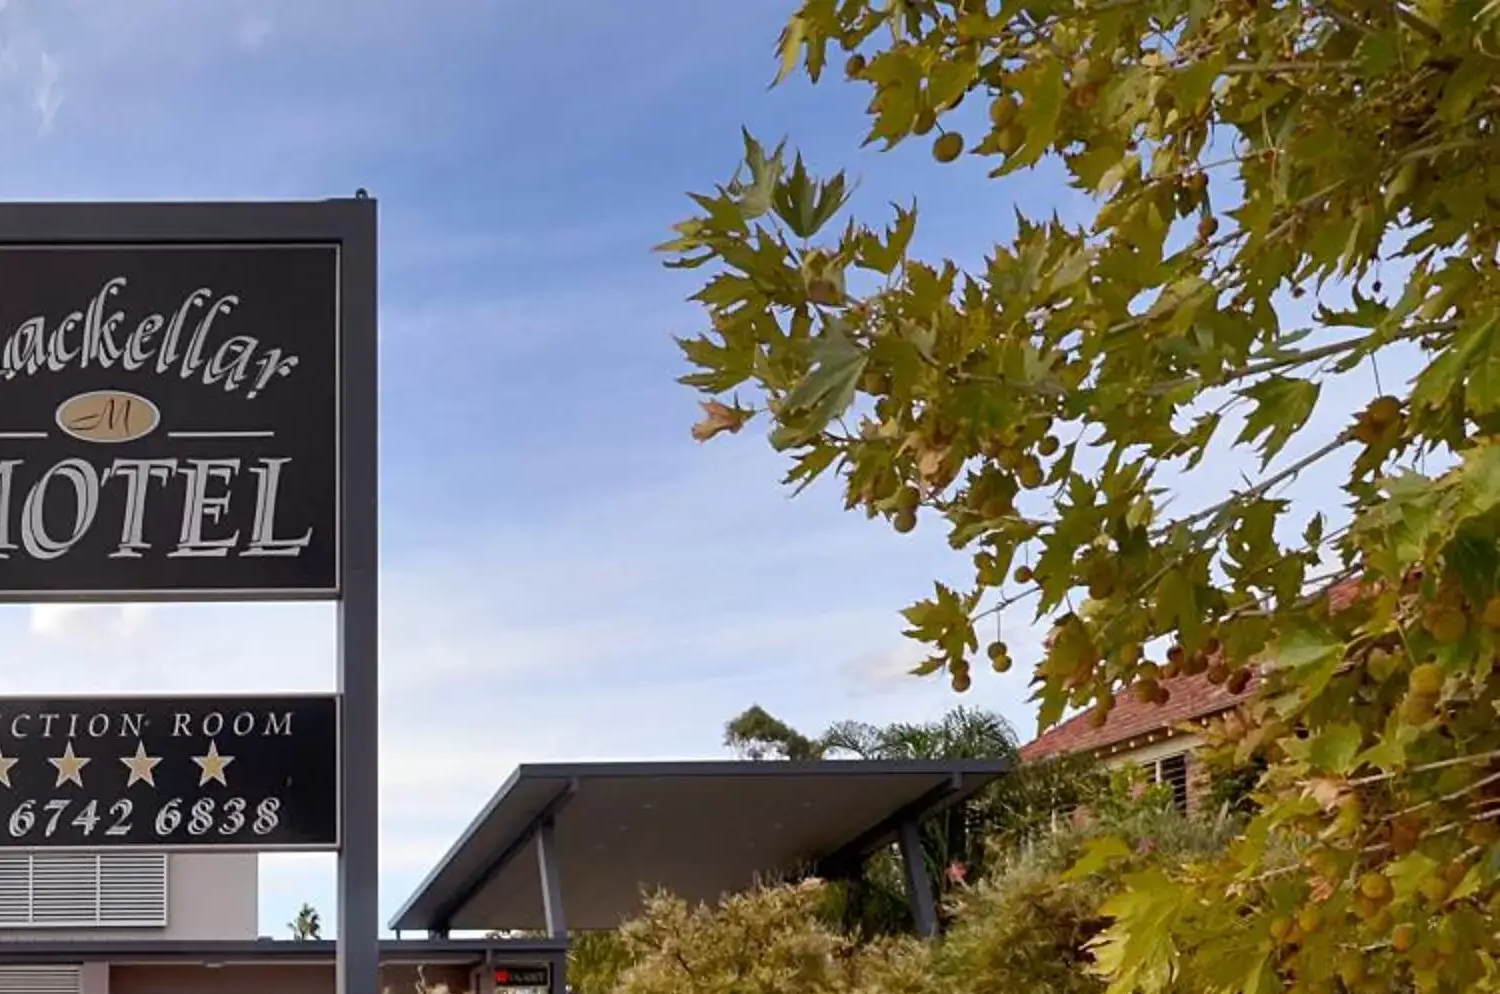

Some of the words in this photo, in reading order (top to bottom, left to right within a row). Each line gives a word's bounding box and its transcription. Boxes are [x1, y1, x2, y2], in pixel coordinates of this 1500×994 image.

[172, 712, 295, 738] ROOM
[8, 798, 134, 838] 6742
[154, 796, 281, 836] 6838
